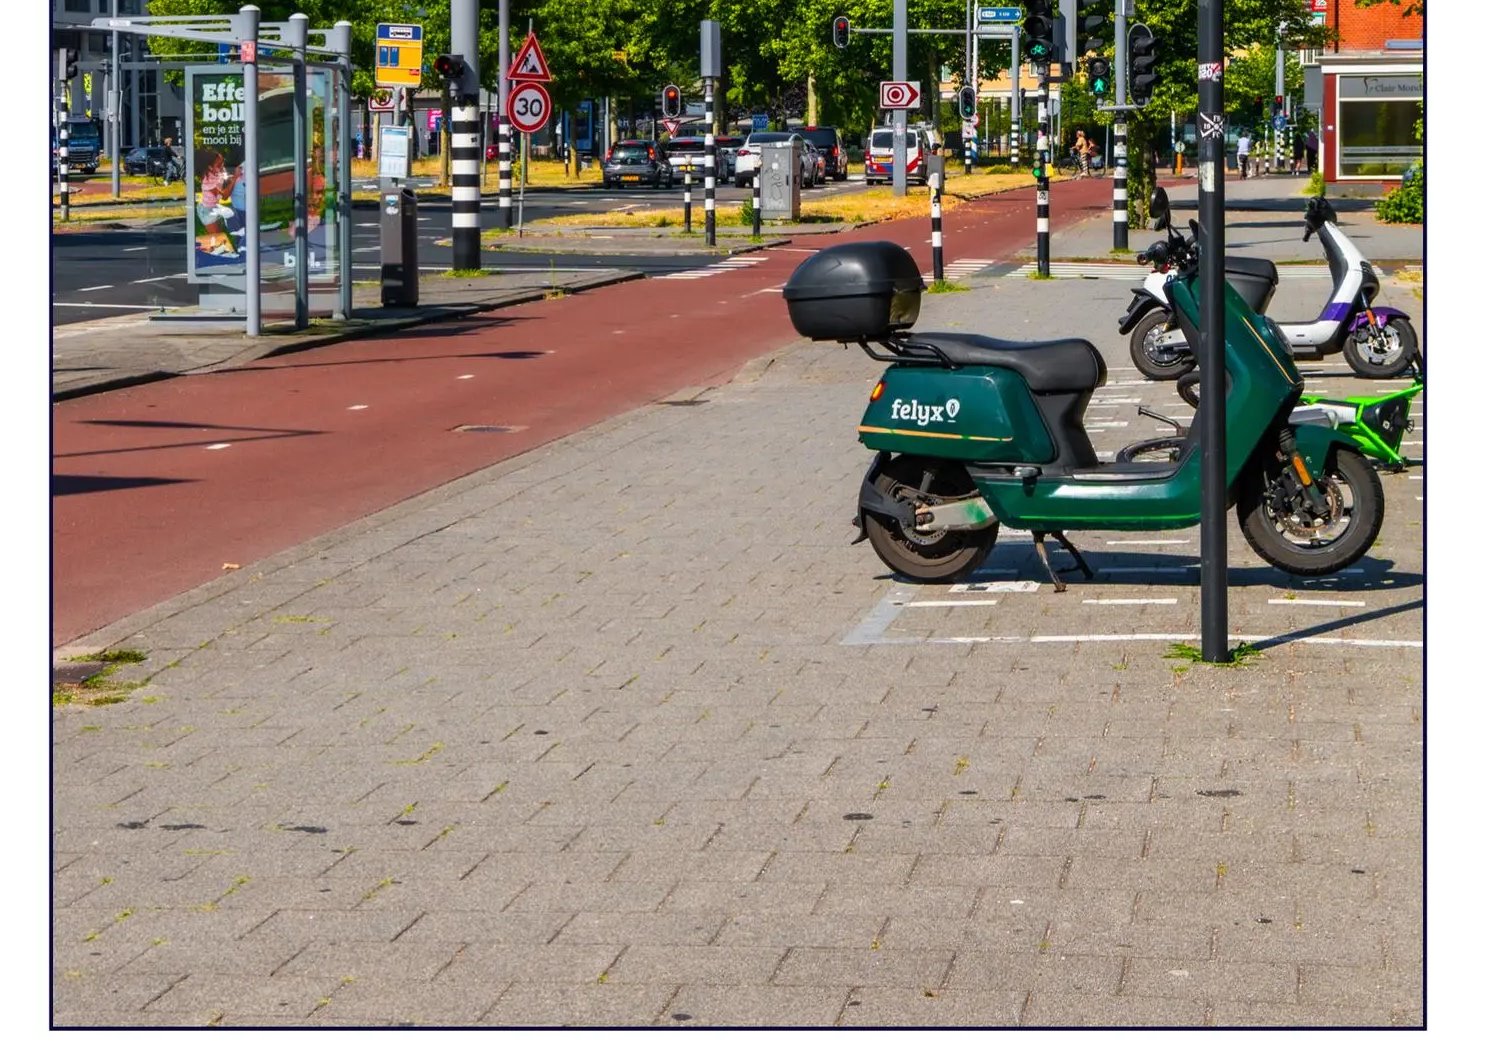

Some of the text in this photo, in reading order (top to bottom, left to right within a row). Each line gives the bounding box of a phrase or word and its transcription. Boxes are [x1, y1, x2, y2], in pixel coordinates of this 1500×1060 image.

[202, 82, 244, 101] Effe
[1374, 84, 1397, 92] Clair
[202, 103, 244, 122] boll
[516, 98, 542, 117] 30
[217, 125, 226, 135] je
[228, 125, 240, 134] zit
[203, 135, 242, 146] mooi bij
[283, 251, 321, 268] bl.
[891, 398, 944, 427] felyx
